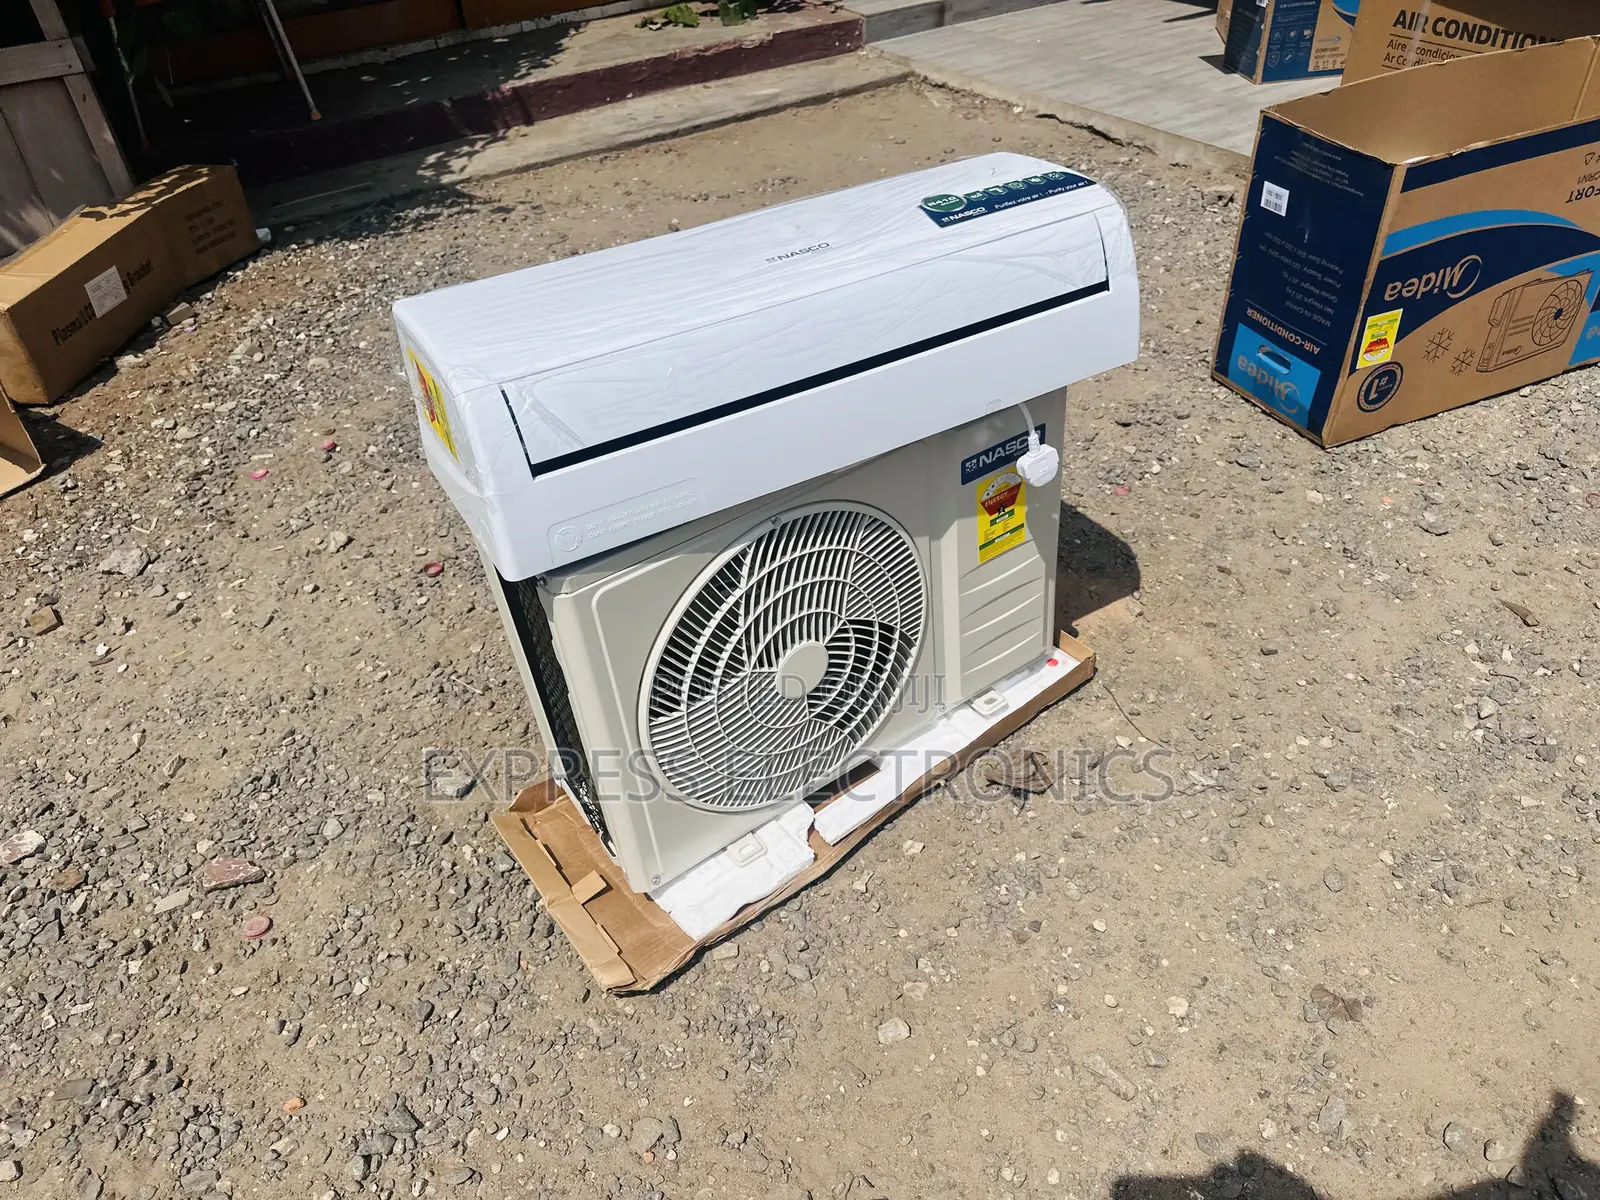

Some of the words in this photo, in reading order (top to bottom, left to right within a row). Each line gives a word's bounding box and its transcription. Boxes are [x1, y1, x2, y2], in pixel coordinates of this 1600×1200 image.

[1432, 16, 1565, 51] CONDITIO
[1386, 39, 1407, 52] Aire
[1383, 52, 1396, 64] Ar
[949, 207, 986, 221] NASCO
[777, 242, 830, 261] NASCO
[1384, 255, 1483, 302] Midea
[1285, 300, 1304, 315] CHINA
[1304, 309, 1312, 318] IN
[1312, 312, 1331, 328] MADE
[1246, 307, 1321, 355] AIR-CONDITIONER
[1237, 355, 1301, 414] Midea
[979, 429, 1041, 468] NASC
